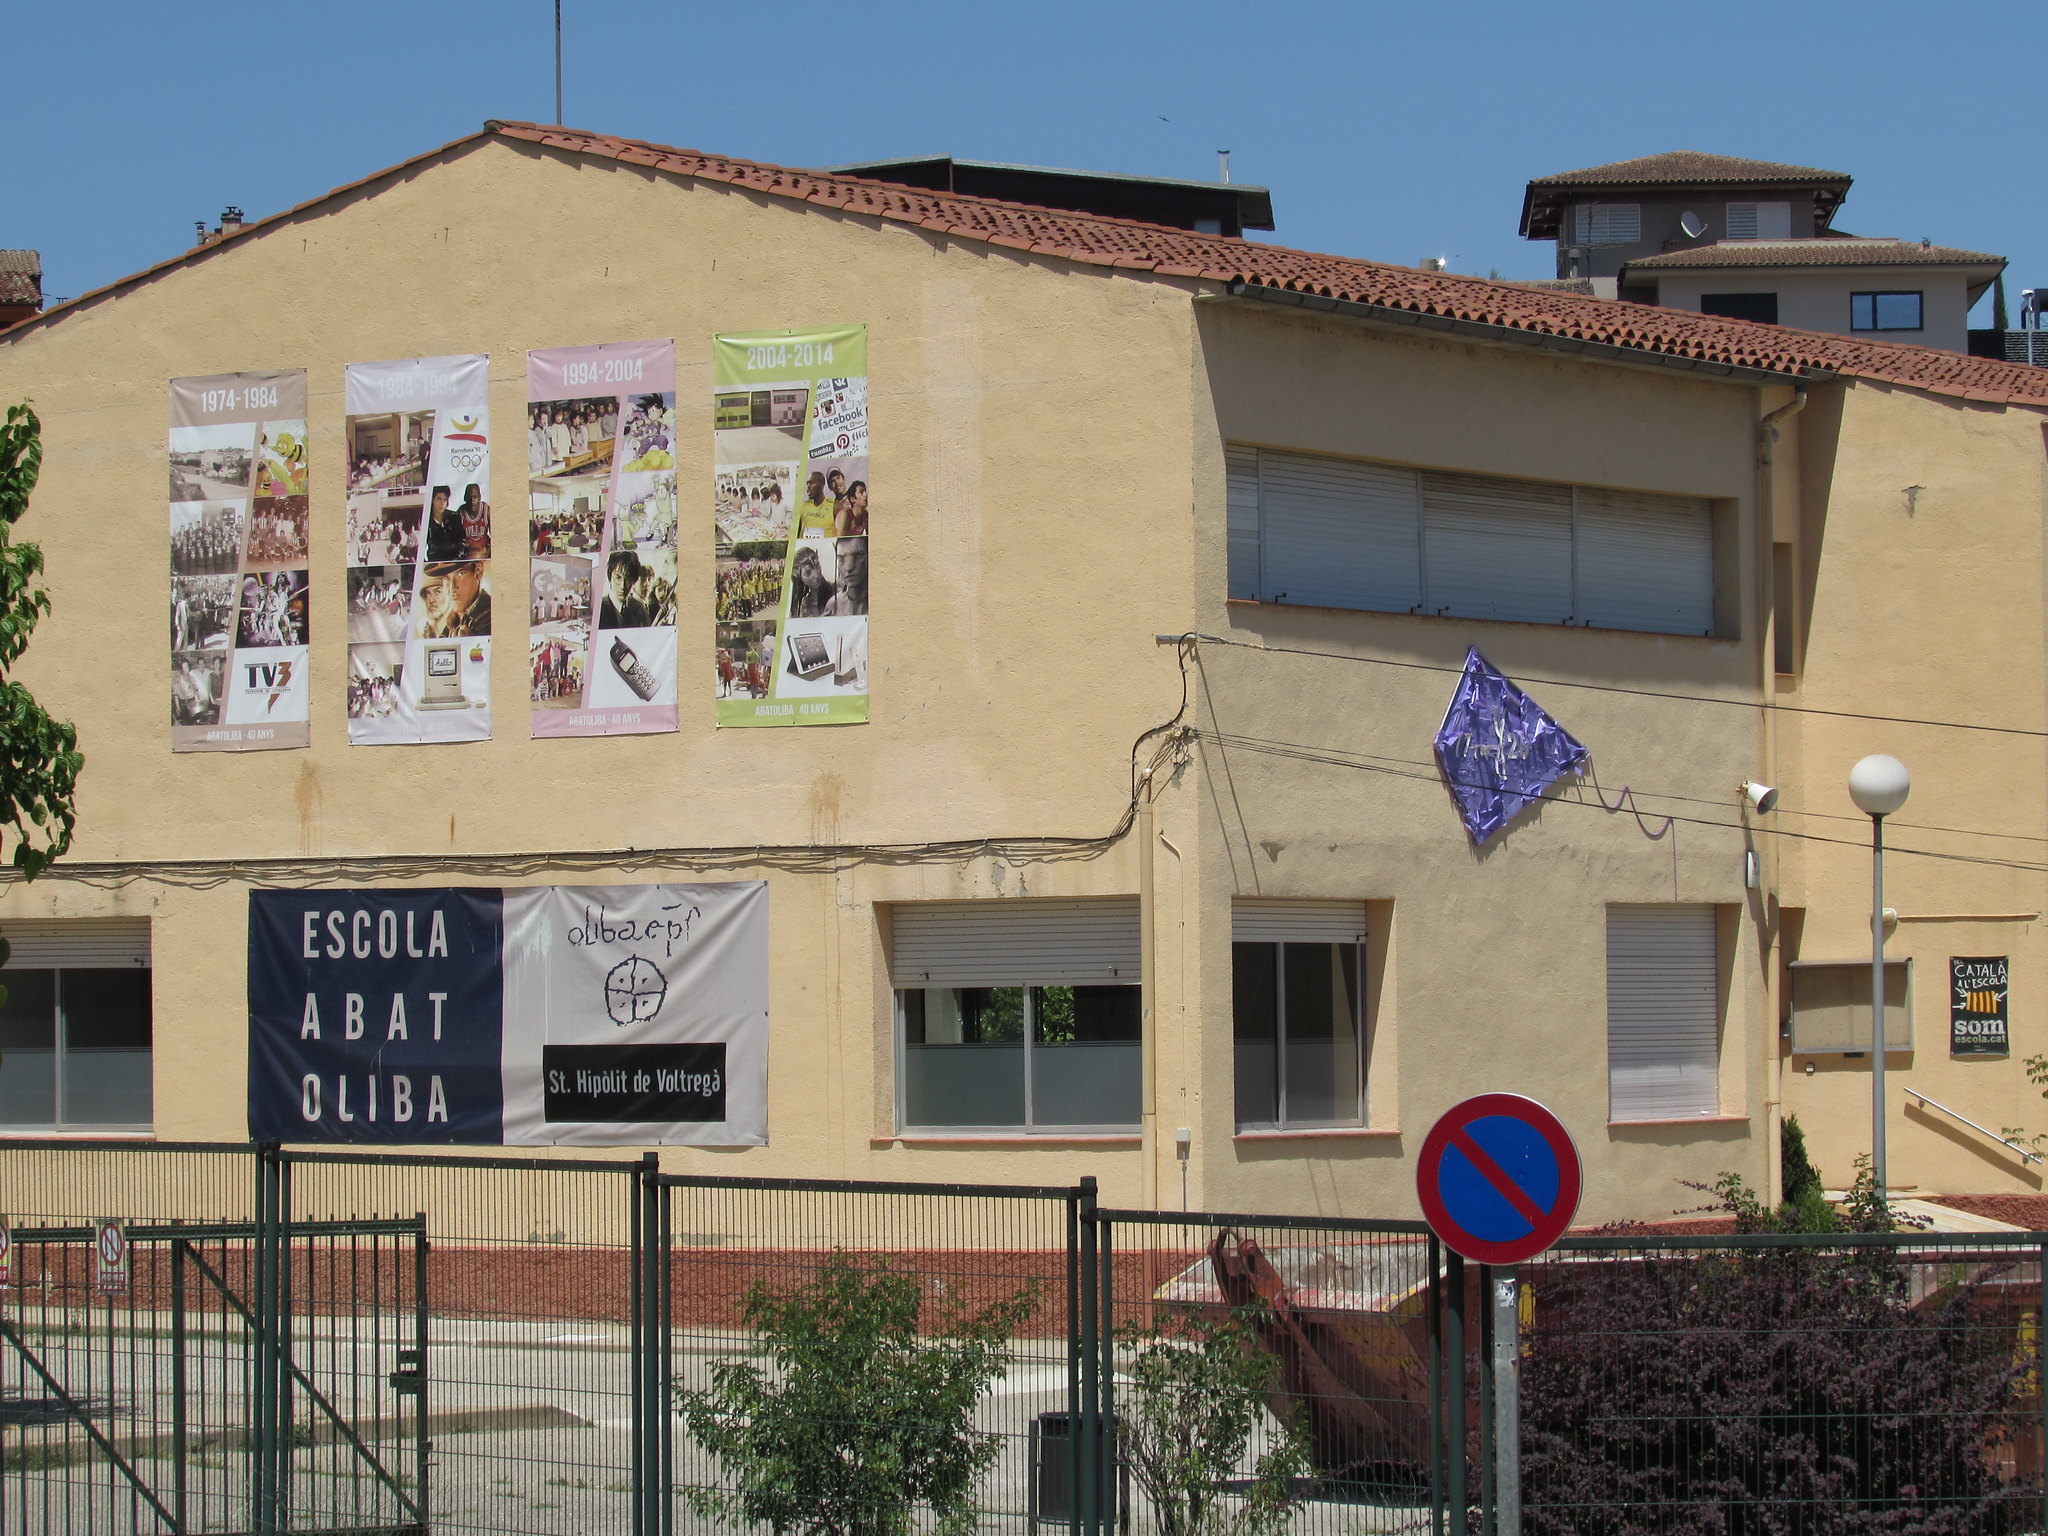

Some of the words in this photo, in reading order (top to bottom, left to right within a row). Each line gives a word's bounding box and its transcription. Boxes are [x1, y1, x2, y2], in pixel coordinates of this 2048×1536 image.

[747, 342, 834, 370] 2004-2014
[561, 357, 643, 386] 1994-2004
[201, 386, 278, 413] 1974-1984
[818, 407, 863, 430] facebook
[244, 661, 292, 689] TV3
[569, 714, 607, 726] ABATOLIBA
[612, 713, 620, 724] 40
[622, 713, 641, 724] ANYS
[756, 704, 794, 717] ABATOLIBA
[799, 703, 809, 714] 40
[811, 703, 830, 714] ANYS
[207, 730, 242, 741] ABATOLIBA
[247, 730, 256, 740] 40
[257, 729, 274, 740] ANYS
[303, 909, 448, 958] ESCOLA
[1954, 961, 2007, 977] CATALÀ
[1964, 976, 2007, 989] L'ESCOLA
[301, 991, 448, 1041] ABAT
[1954, 1020, 2006, 1035] som
[1955, 1035, 2006, 1044] escola.cat
[549, 1070, 571, 1094] St.
[577, 1069, 627, 1098] Hipòlit
[633, 1070, 650, 1093] de
[656, 1069, 721, 1098] Voltregà
[302, 1072, 448, 1123] OLIBA
